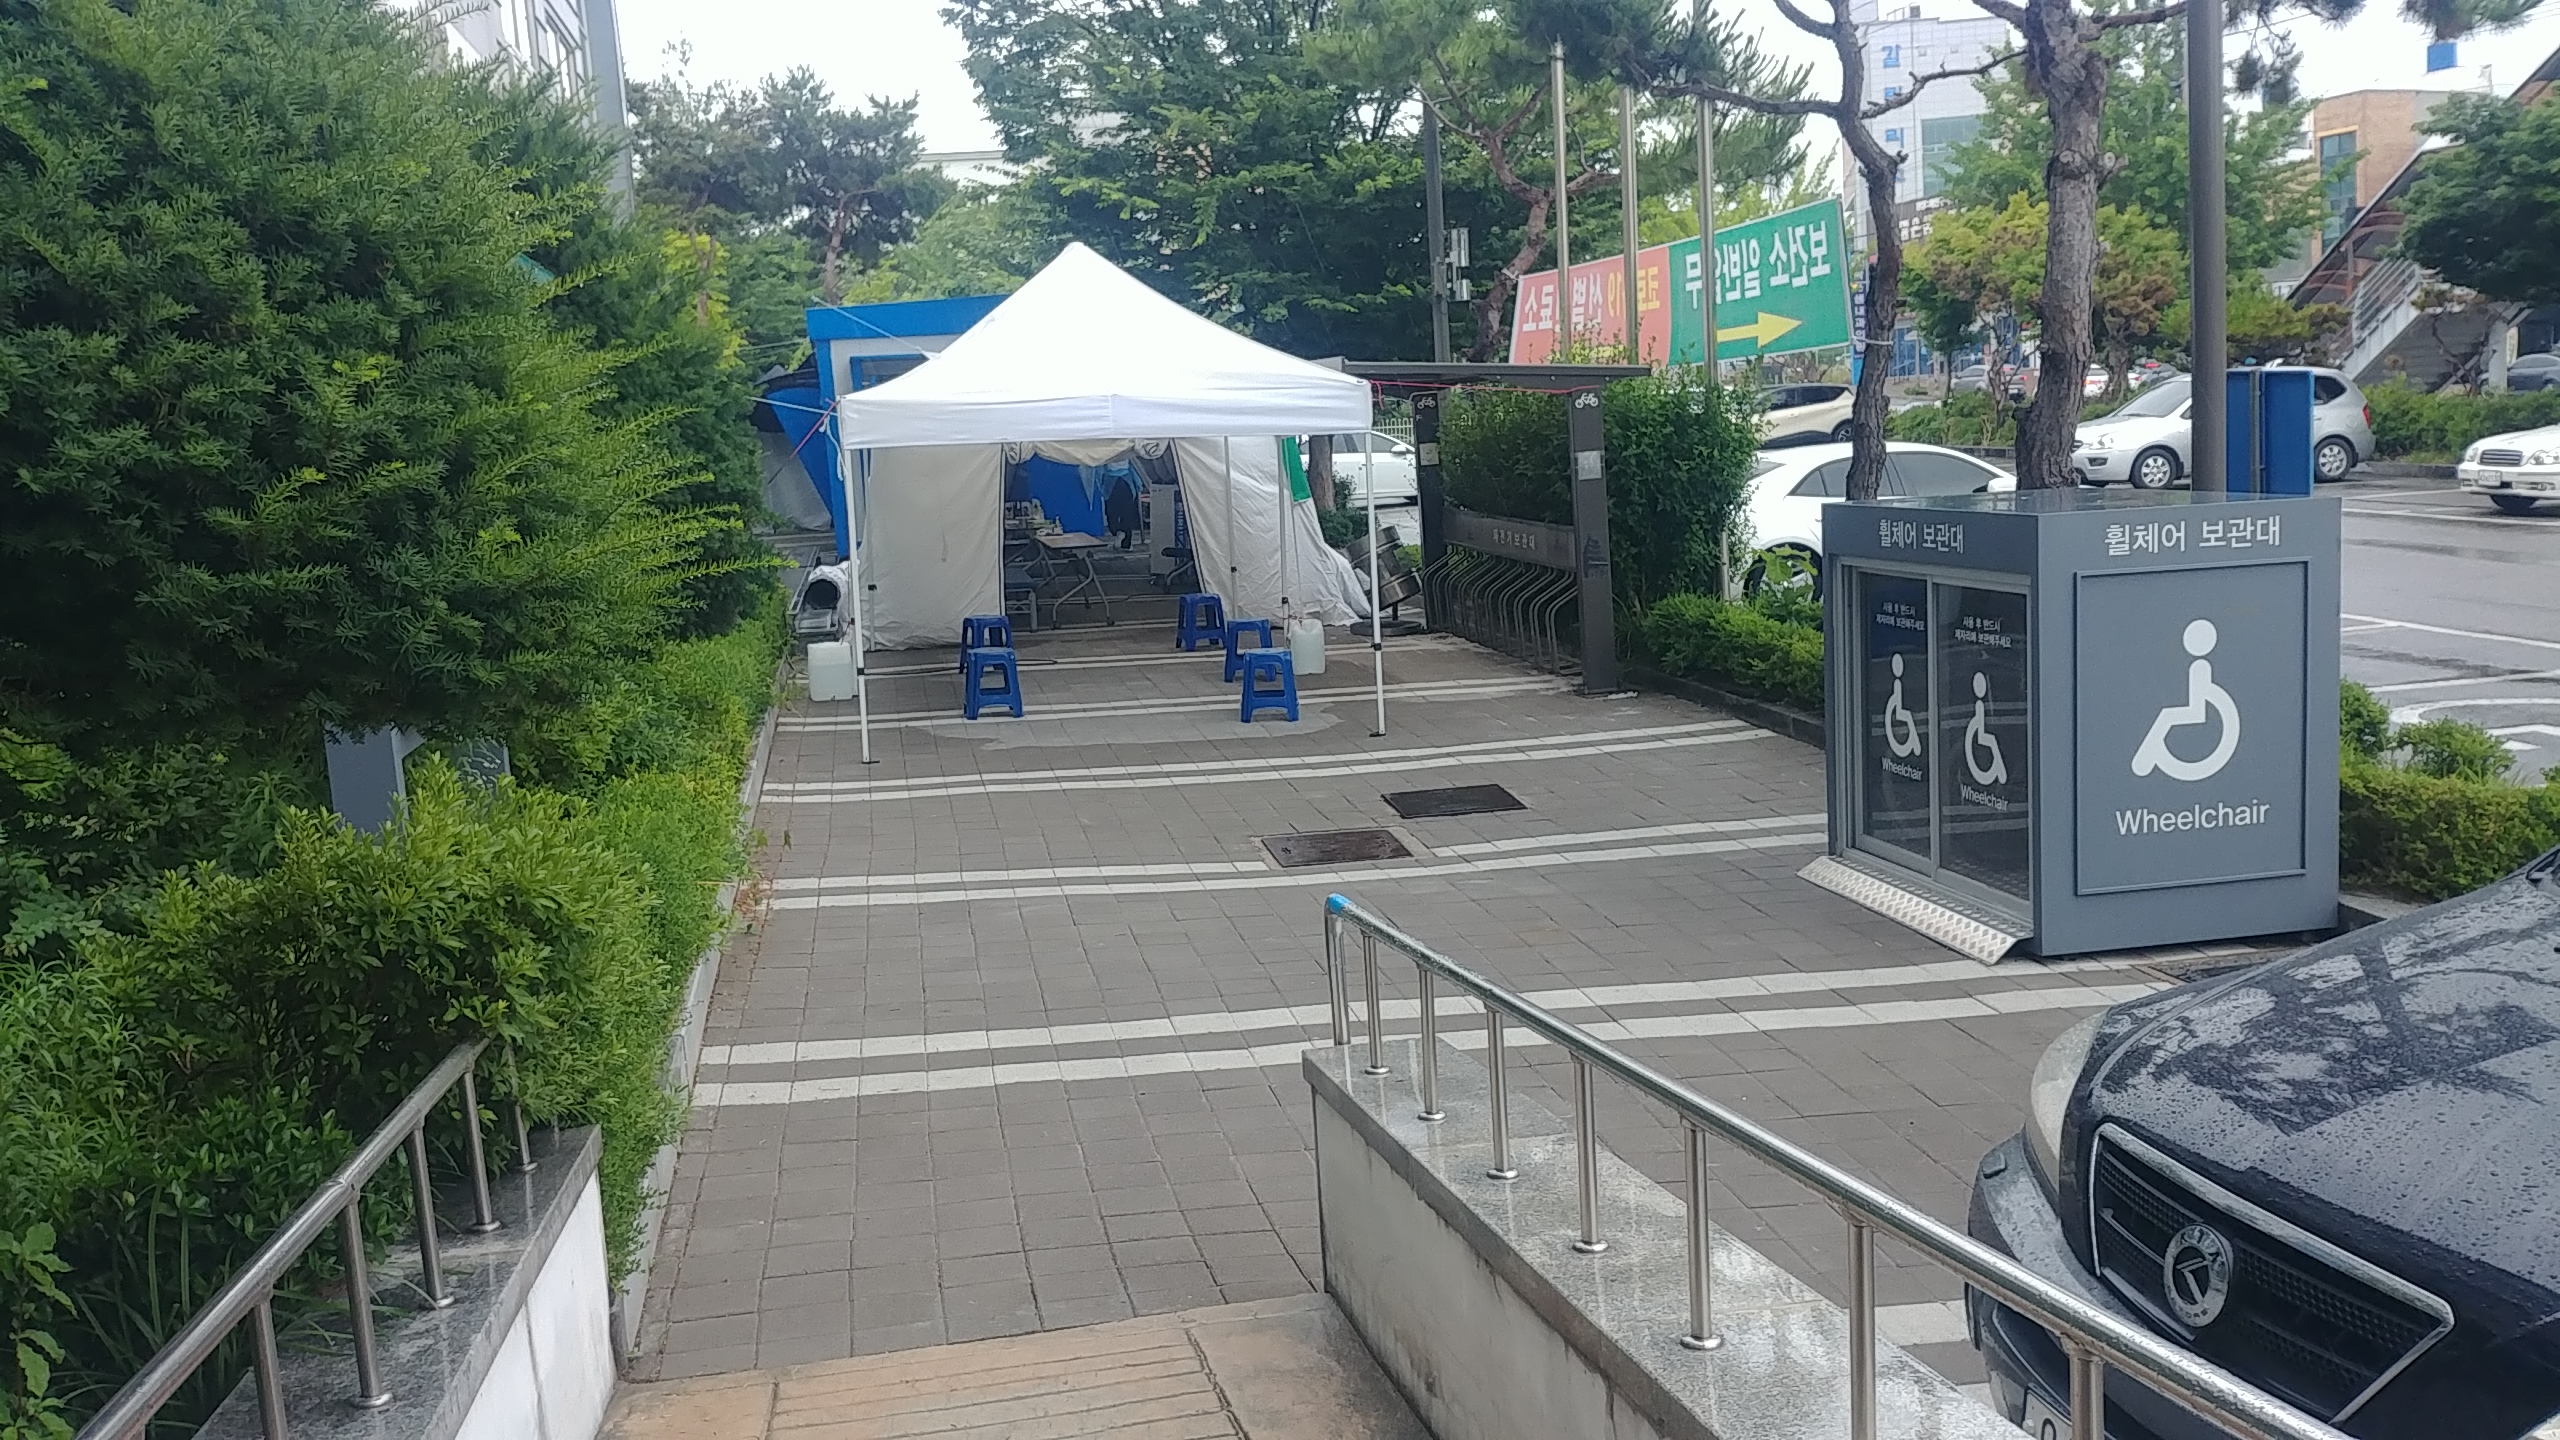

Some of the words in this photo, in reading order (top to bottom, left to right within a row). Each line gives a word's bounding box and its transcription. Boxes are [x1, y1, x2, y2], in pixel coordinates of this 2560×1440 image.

[1878, 519, 1917, 550] 휠체어
[1921, 522, 1964, 554] 보관대
[2104, 521, 2186, 556] 휠체어
[2198, 515, 2281, 549] 보관대
[1954, 628, 1976, 642] 제자리에
[1962, 616, 1974, 629] 사용
[1975, 617, 1982, 629] 후
[1983, 618, 2000, 632] 반드시
[1881, 756, 1923, 782] Wheelchair
[1960, 783, 2009, 811] Wheelchair
[2115, 799, 2271, 836] Wheelchair
